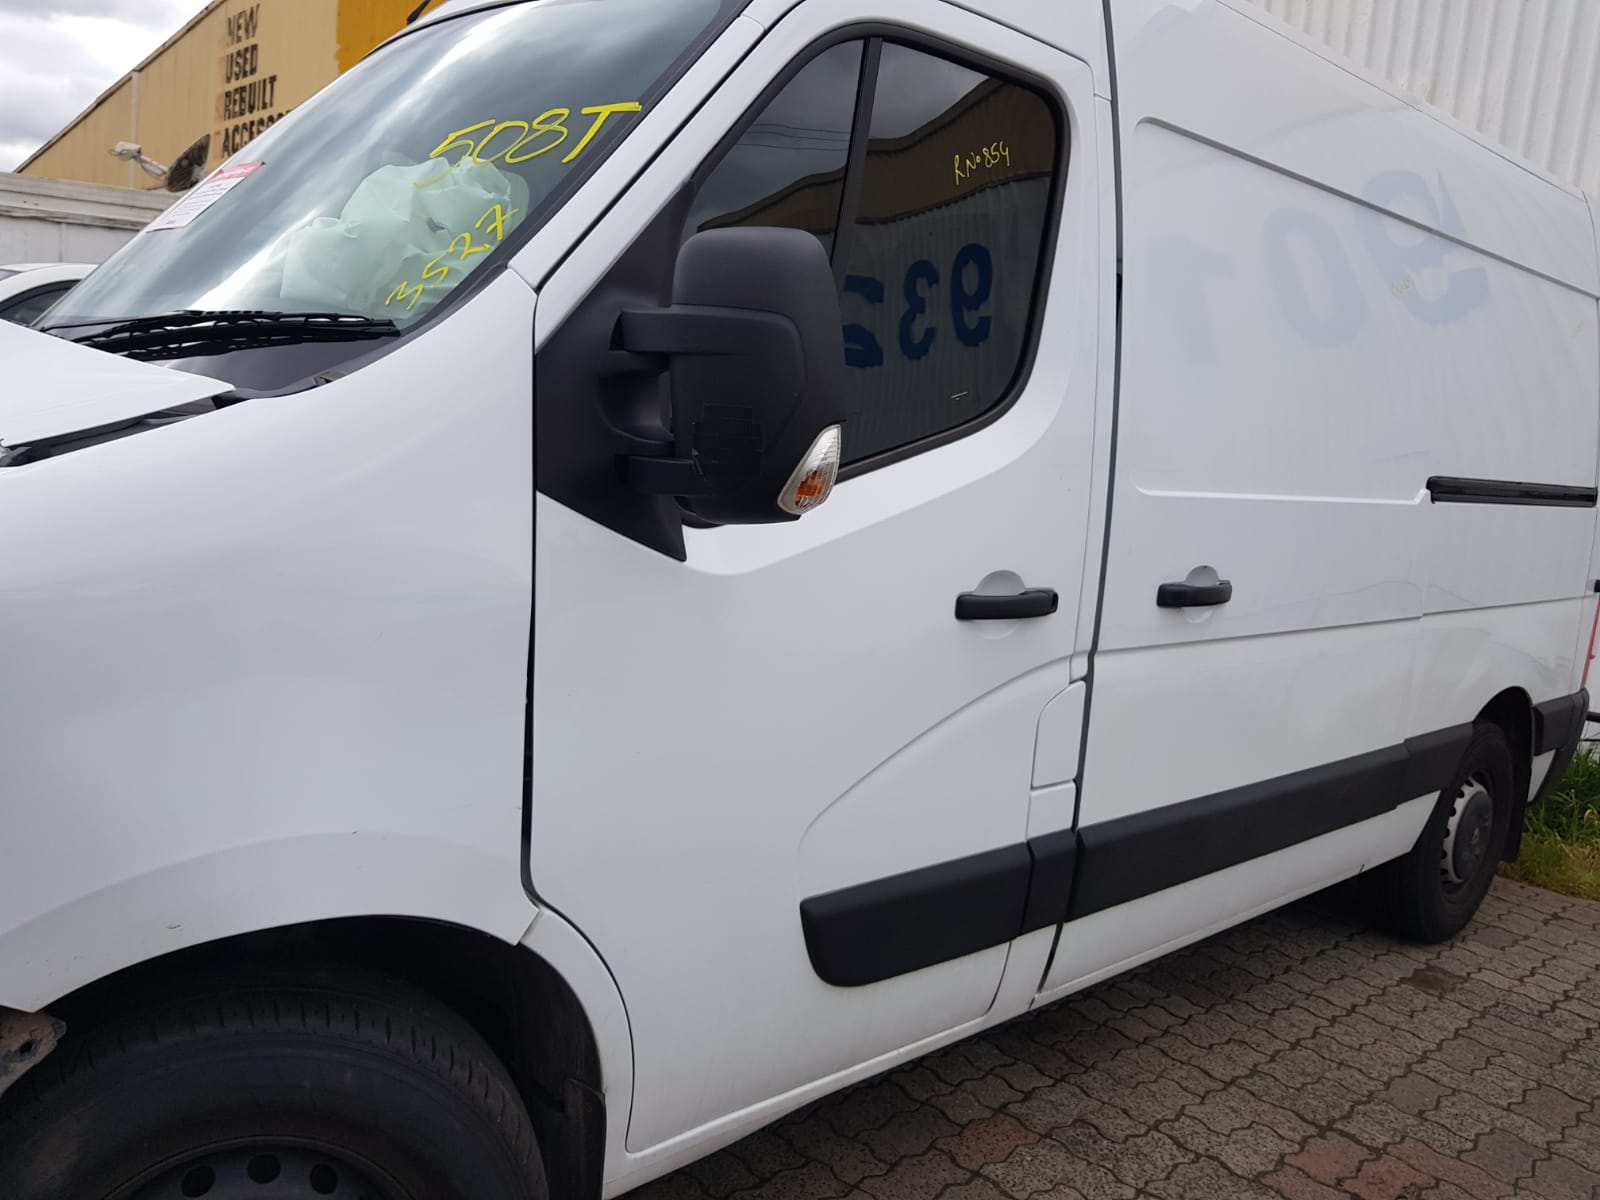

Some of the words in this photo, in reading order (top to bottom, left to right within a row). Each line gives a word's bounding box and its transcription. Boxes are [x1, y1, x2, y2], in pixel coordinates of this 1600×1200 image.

[227, 3, 260, 46] NEW
[225, 44, 258, 83] USED
[224, 75, 277, 120] REBUILT
[414, 102, 642, 188] 508T
